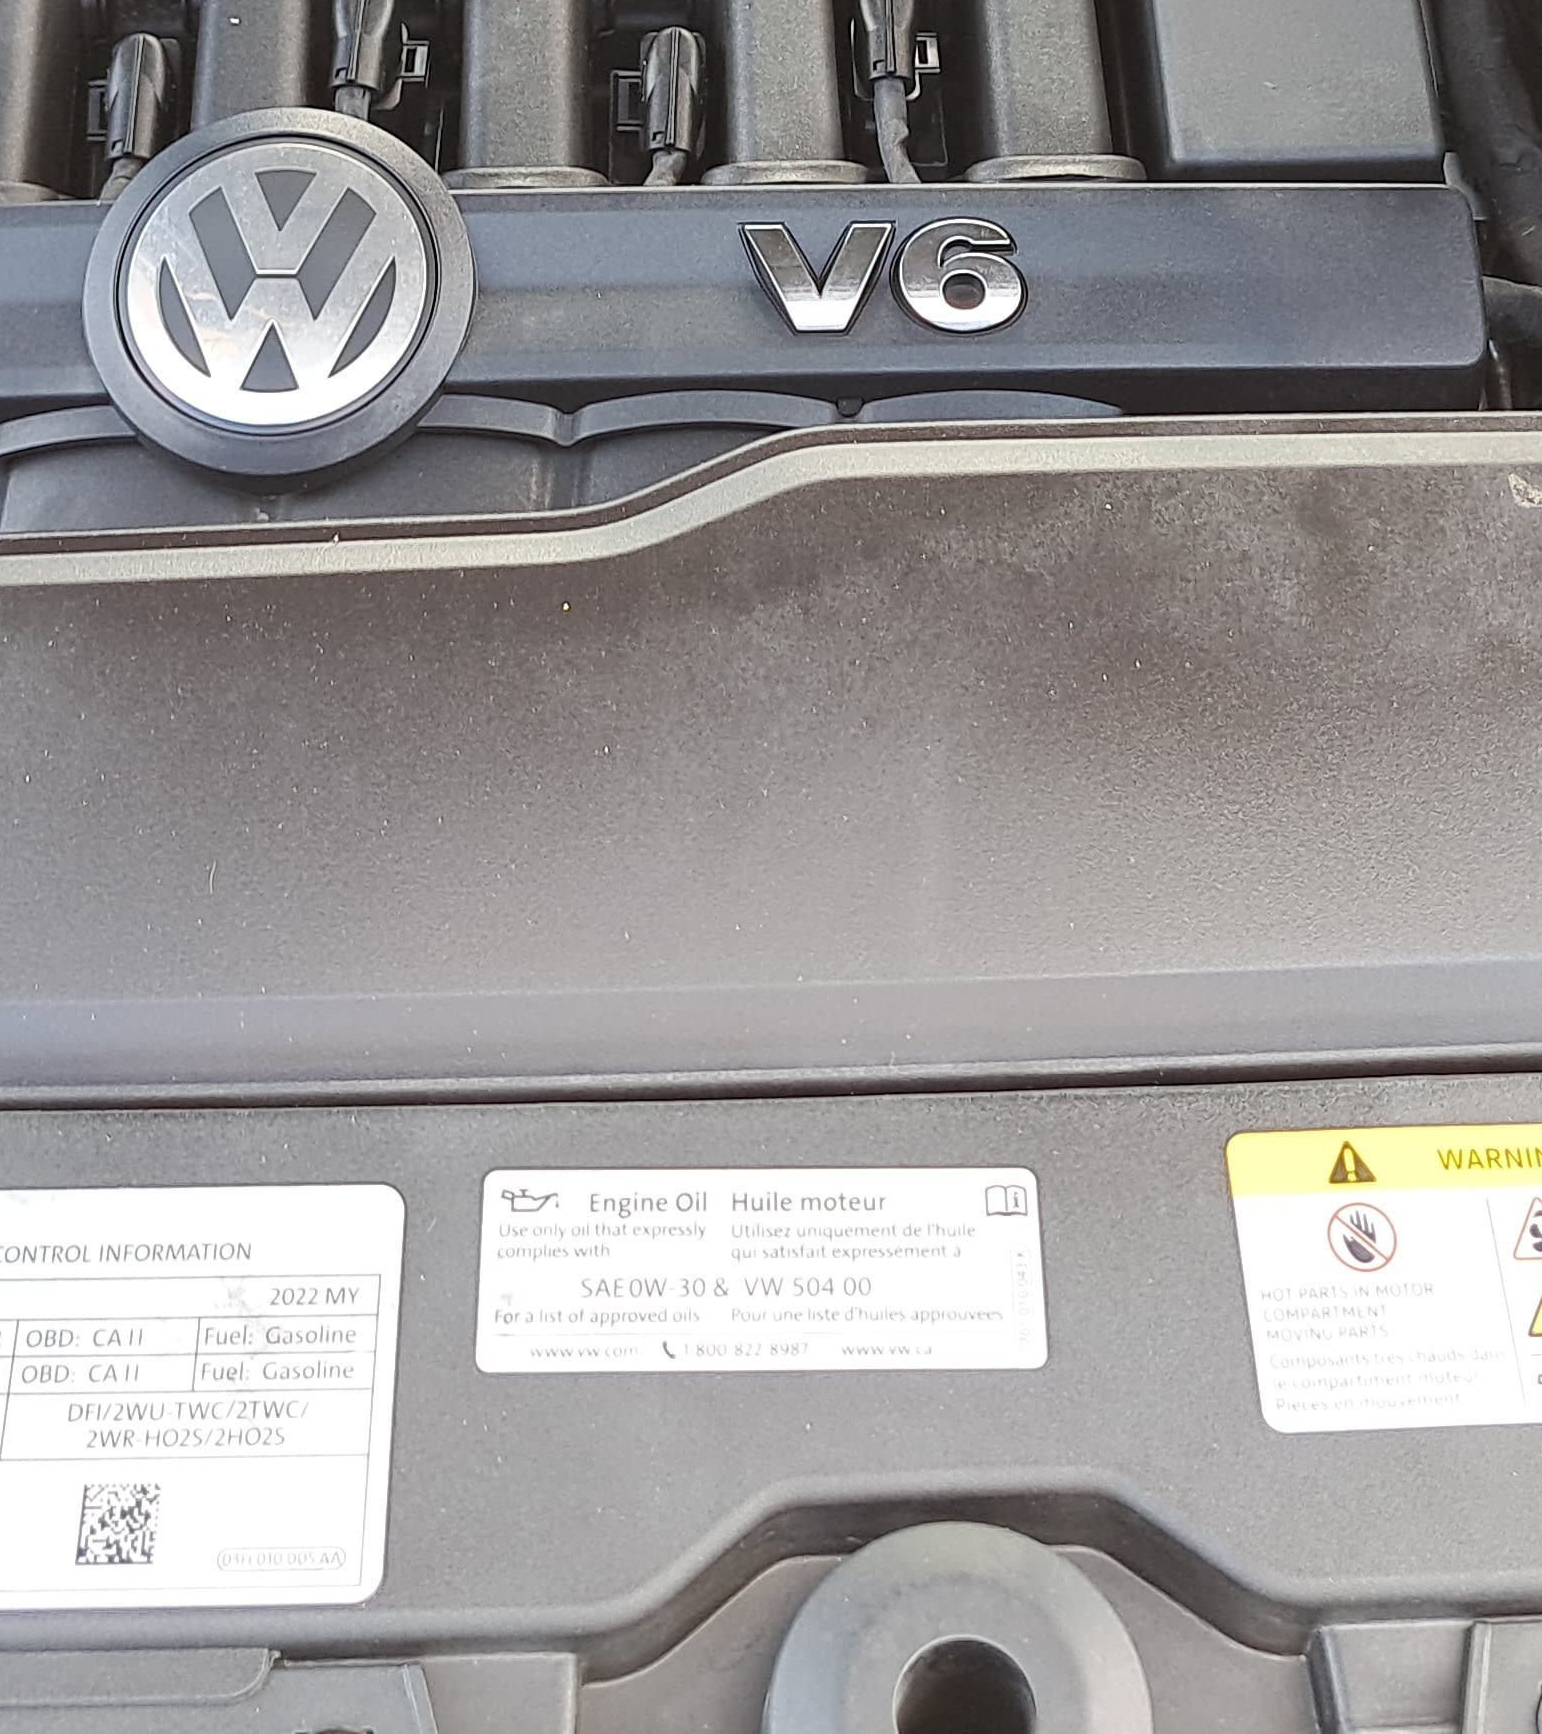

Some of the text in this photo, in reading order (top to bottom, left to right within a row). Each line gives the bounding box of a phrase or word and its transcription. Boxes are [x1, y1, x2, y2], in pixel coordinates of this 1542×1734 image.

[119, 138, 434, 431] VW
[737, 214, 1027, 336] V6
[589, 1191, 887, 1218] Engine Oil Huile moteur
[498, 1222, 707, 1240] Use only oil that expressly
[731, 1222, 976, 1240] Utilisez uniquement de l'huile
[99, 1242, 253, 1263] INFORMATION
[497, 1244, 610, 1262] complies with
[731, 1244, 757, 1263] qui
[761, 1244, 827, 1259] satisfait
[269, 1287, 360, 1306] 2022 MY
[713, 1277, 730, 1298] &
[744, 1277, 784, 1297] VW
[792, 1277, 835, 1297] 504
[843, 1277, 873, 1296] 00
[1260, 1282, 1436, 1302] HOT PARTS IN MOTOR
[494, 1308, 700, 1327] For a list of approved oils
[731, 1307, 768, 1322] Pour
[773, 1311, 804, 1322] une
[807, 1308, 841, 1322] liste
[1263, 1304, 1387, 1322] COMPARTMENT
[25, 1328, 81, 1348] OBD:
[204, 1326, 254, 1346] Fuel:
[264, 1325, 357, 1346] Gasoline
[1266, 1324, 1389, 1343] MOVING PARTS
[20, 1364, 76, 1384] OBD:
[200, 1361, 251, 1382] Fuel:
[261, 1360, 355, 1381] Gasoline
